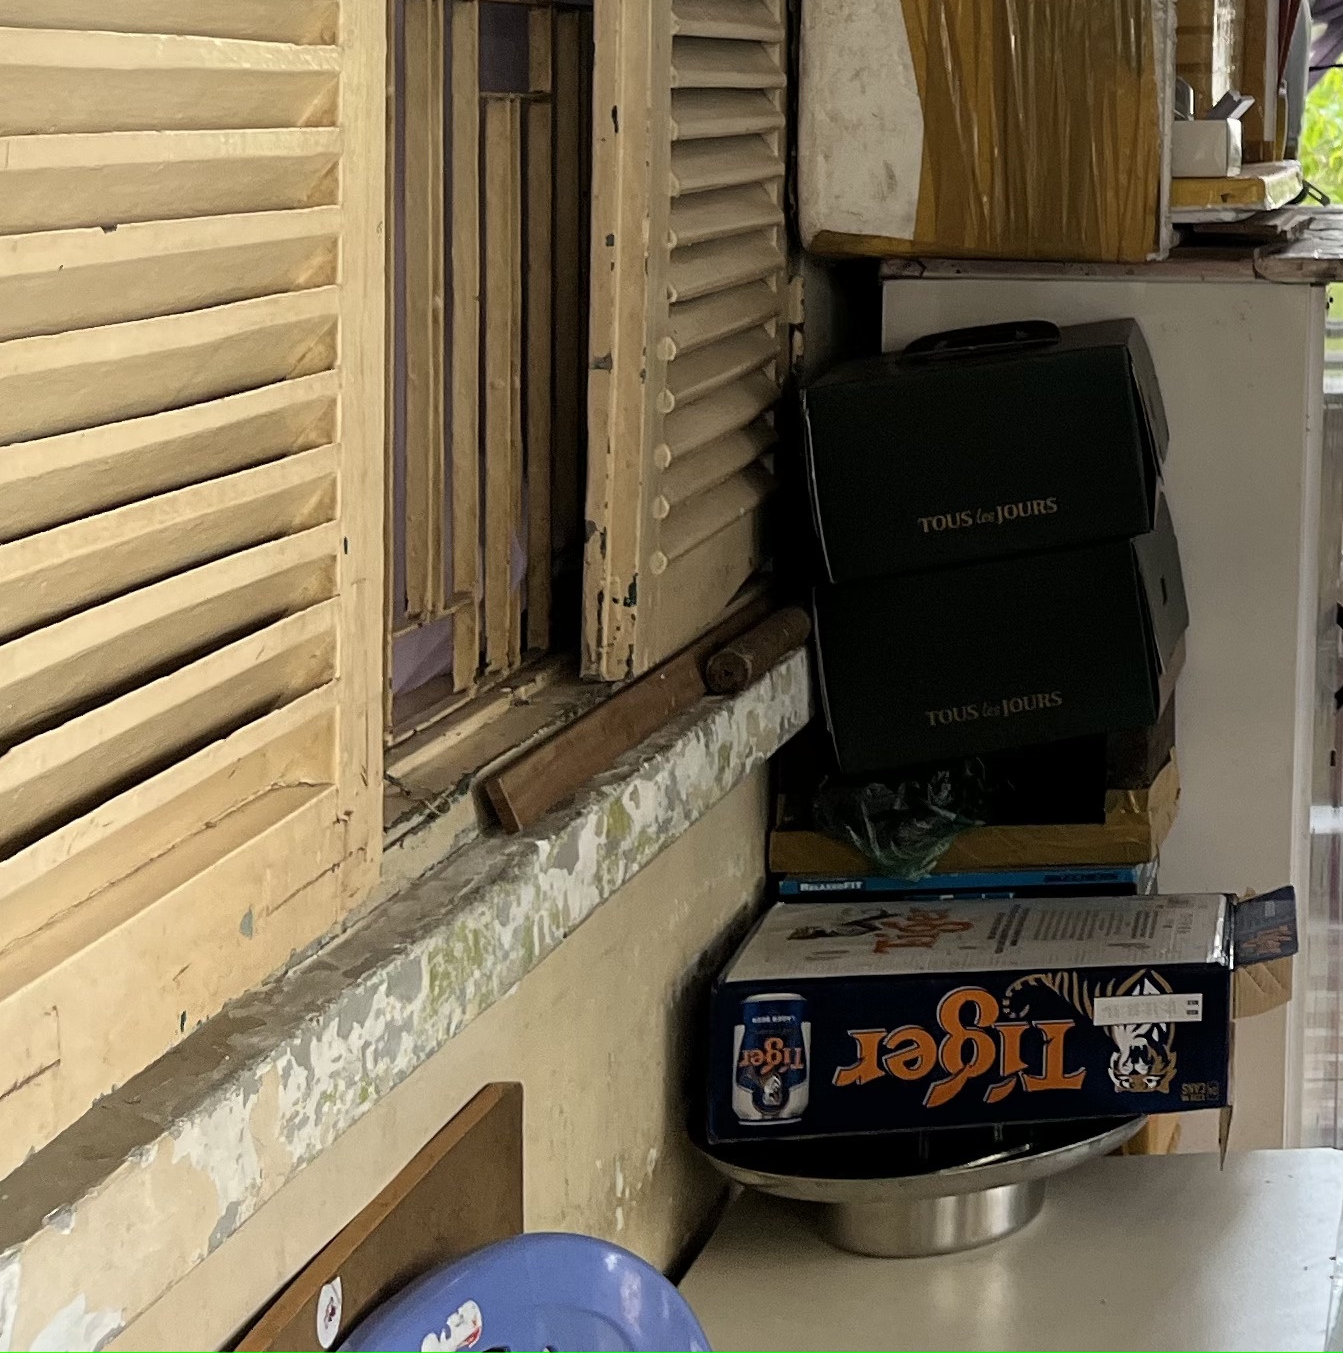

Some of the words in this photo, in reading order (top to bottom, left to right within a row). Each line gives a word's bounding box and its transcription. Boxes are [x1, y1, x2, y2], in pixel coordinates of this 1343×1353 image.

[919, 511, 973, 533] TOUS
[995, 497, 1058, 523] JOURS
[927, 704, 979, 726] TOUS
[1000, 691, 1062, 718] JOURS
[738, 1037, 805, 1074] Tiger
[831, 985, 1088, 1109] Tiger
